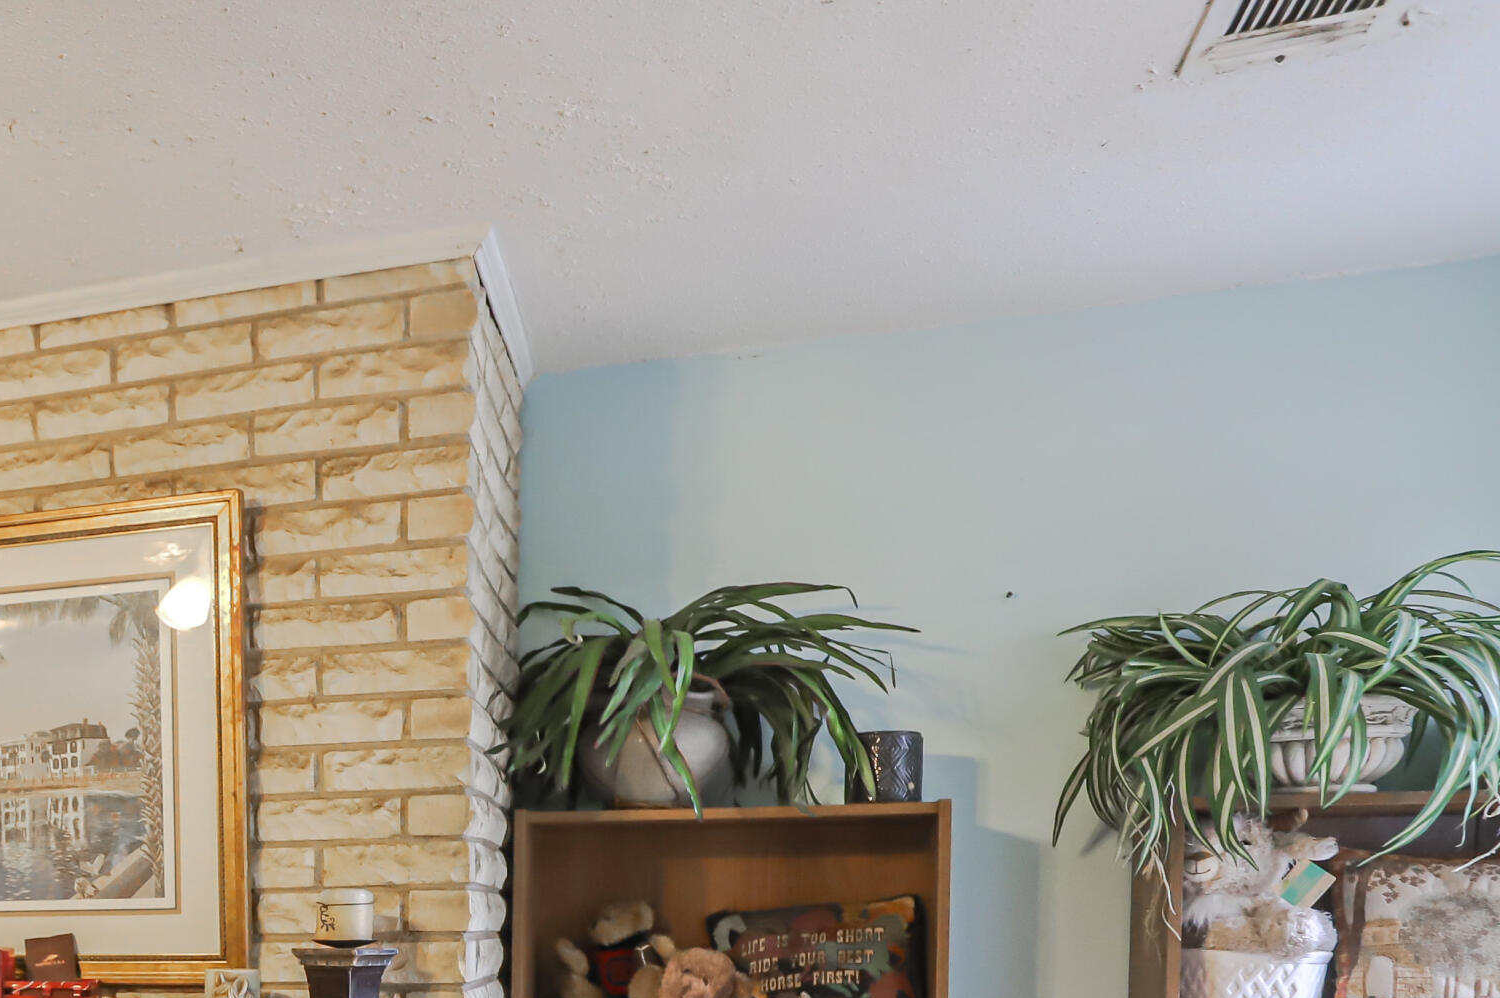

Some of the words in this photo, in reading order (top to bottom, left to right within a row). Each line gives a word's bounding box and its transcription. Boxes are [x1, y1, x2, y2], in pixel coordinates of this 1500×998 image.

[741, 937, 766, 957] LIFE
[777, 934, 788, 948] IS
[802, 933, 826, 944] TOO
[837, 927, 884, 943] SHORT
[750, 957, 778, 974] RIDE
[791, 951, 825, 968] YOUR
[839, 950, 874, 965] BEST
[761, 974, 802, 992] HORSE
[813, 970, 860, 985] FIRST!
